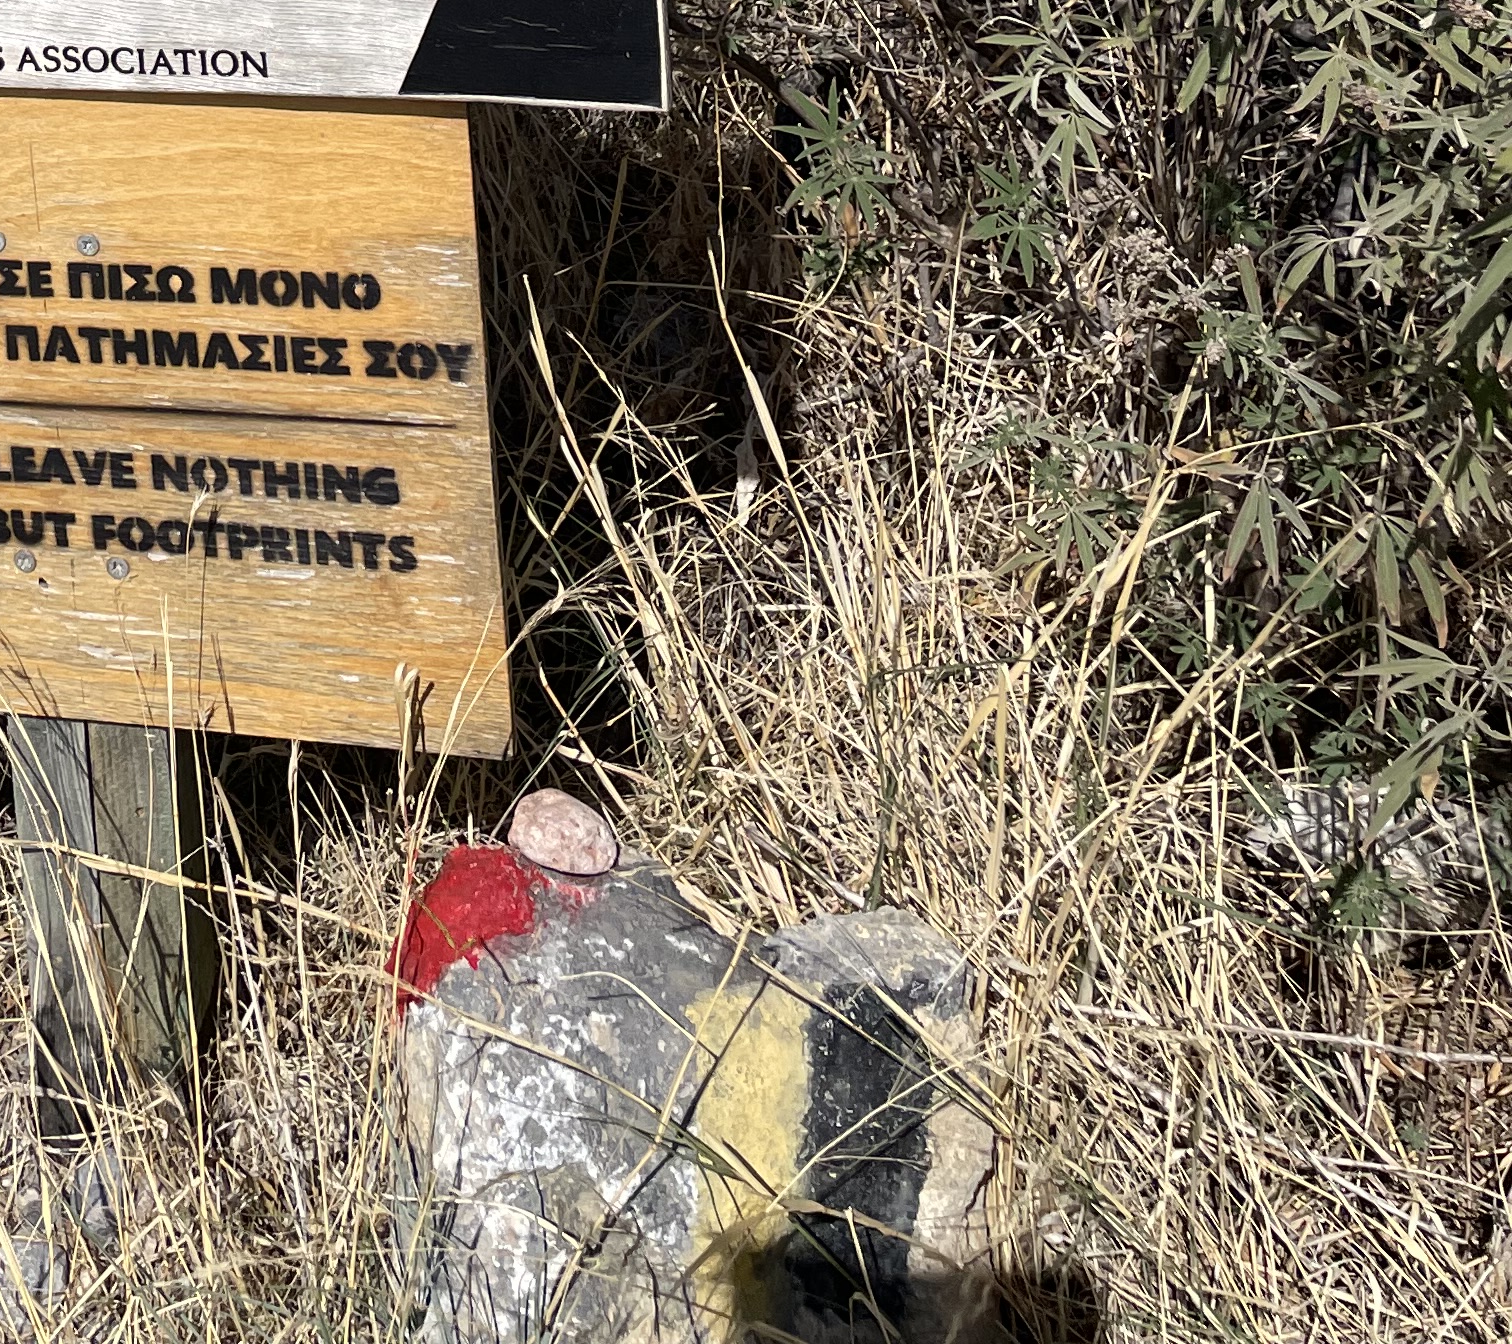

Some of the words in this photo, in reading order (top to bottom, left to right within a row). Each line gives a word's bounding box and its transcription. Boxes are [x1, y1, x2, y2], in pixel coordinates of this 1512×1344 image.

[17, 45, 269, 78] ASSOCIATION
[66, 261, 197, 304] ΠΙΣΩ
[209, 267, 382, 311] ΜΟΝΟ
[4, 324, 352, 376] ΠΑΤΗΜΑΣΙΕΣ
[362, 340, 473, 383] ΣΟΥ
[150, 453, 401, 506] NOTHING
[90, 514, 418, 574] FOOTPRINTS
